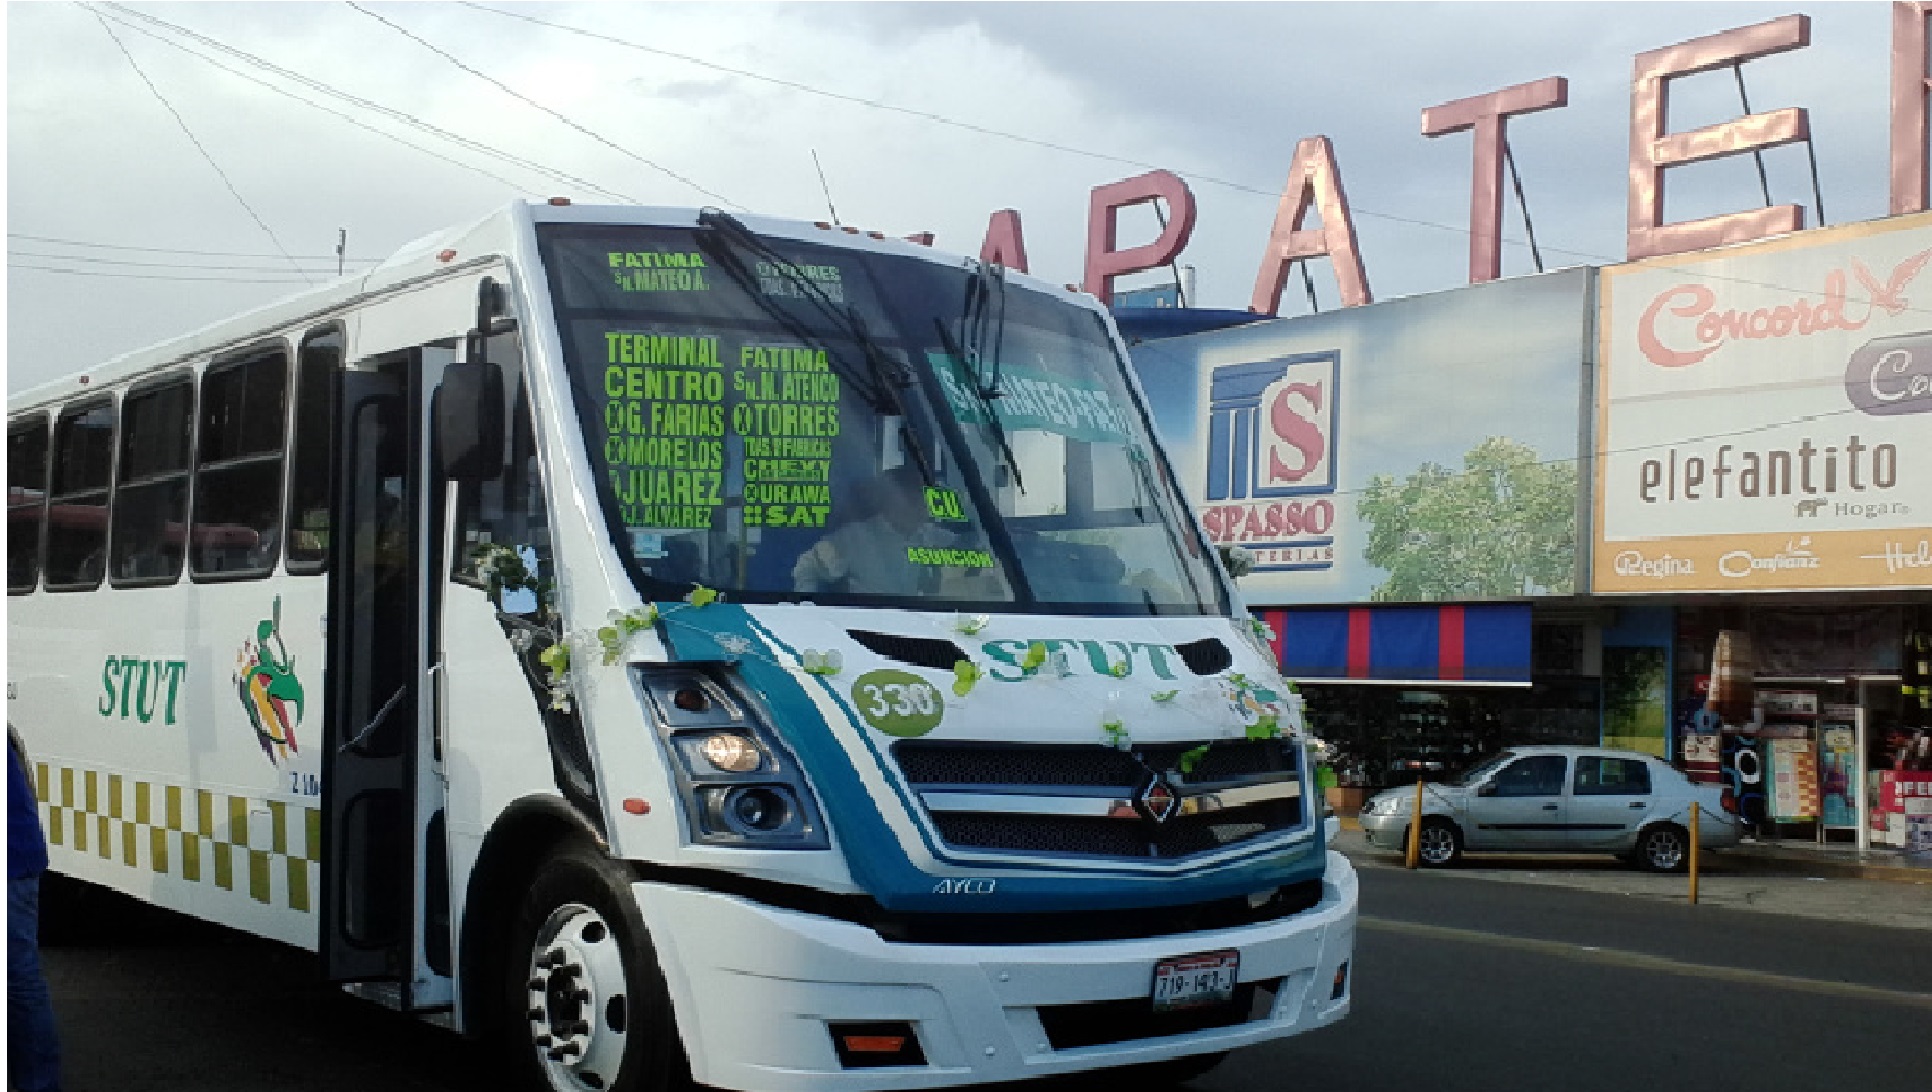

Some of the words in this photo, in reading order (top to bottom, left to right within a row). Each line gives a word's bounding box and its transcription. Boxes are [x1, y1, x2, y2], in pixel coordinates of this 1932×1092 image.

[607, 253, 706, 267] FATIMA
[1638, 269, 1872, 367] Concord
[605, 332, 724, 367] TERMINAL
[742, 346, 829, 371] FATIMA
[605, 366, 724, 401] CENTRO
[652, 403, 724, 436] FARIAS
[755, 403, 840, 436] TORRES
[1270, 379, 1325, 484] S
[626, 436, 723, 470] MORELOS
[1639, 436, 1897, 503] elefantito
[623, 470, 724, 505] JUAREZ
[645, 506, 711, 528] ALVAREZ
[766, 505, 829, 527] SAT
[1203, 500, 1334, 542] SPASSO
[1614, 551, 1698, 579] Regina
[982, 638, 1178, 682] STUT
[99, 655, 188, 726] STUT
[862, 682, 936, 718] 330
